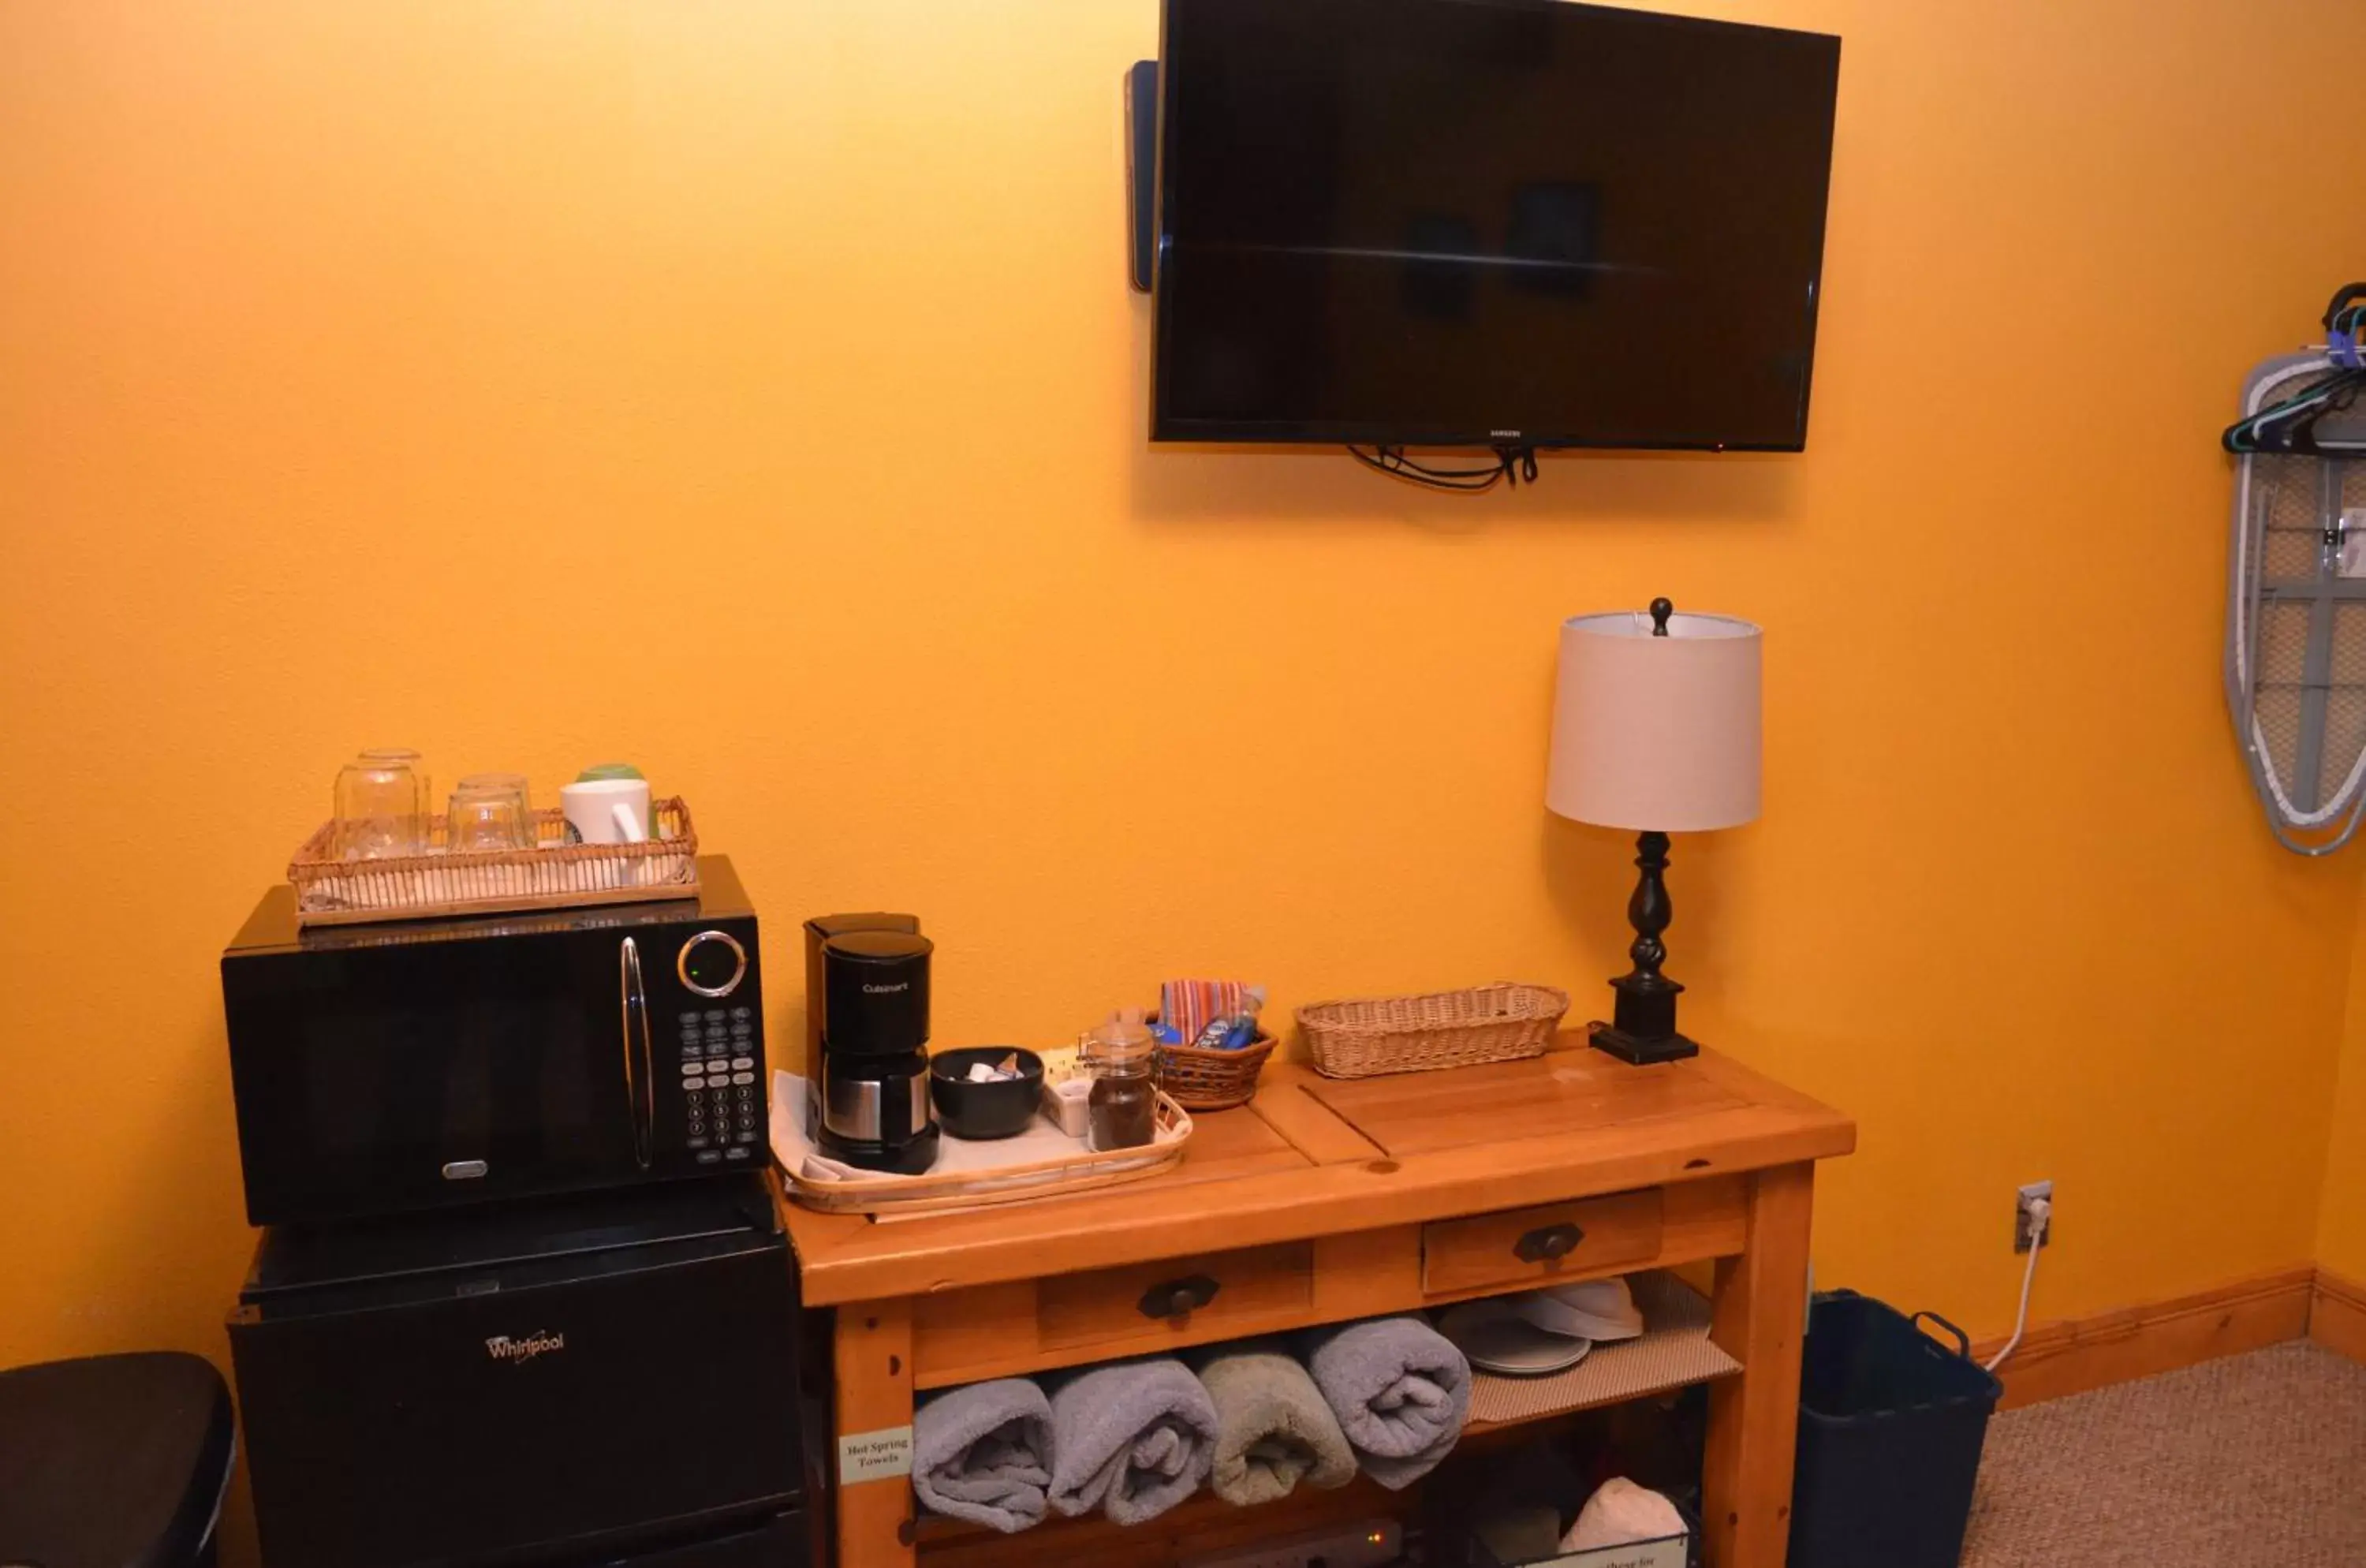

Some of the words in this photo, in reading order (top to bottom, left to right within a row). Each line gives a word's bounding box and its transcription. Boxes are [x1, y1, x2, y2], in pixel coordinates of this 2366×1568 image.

[862, 982, 909, 993] Cuisinart
[487, 1332, 564, 1358] Whirlpool
[847, 1444, 868, 1455] Hot
[871, 1439, 908, 1453] Spring
[858, 1454, 898, 1468] Towels
